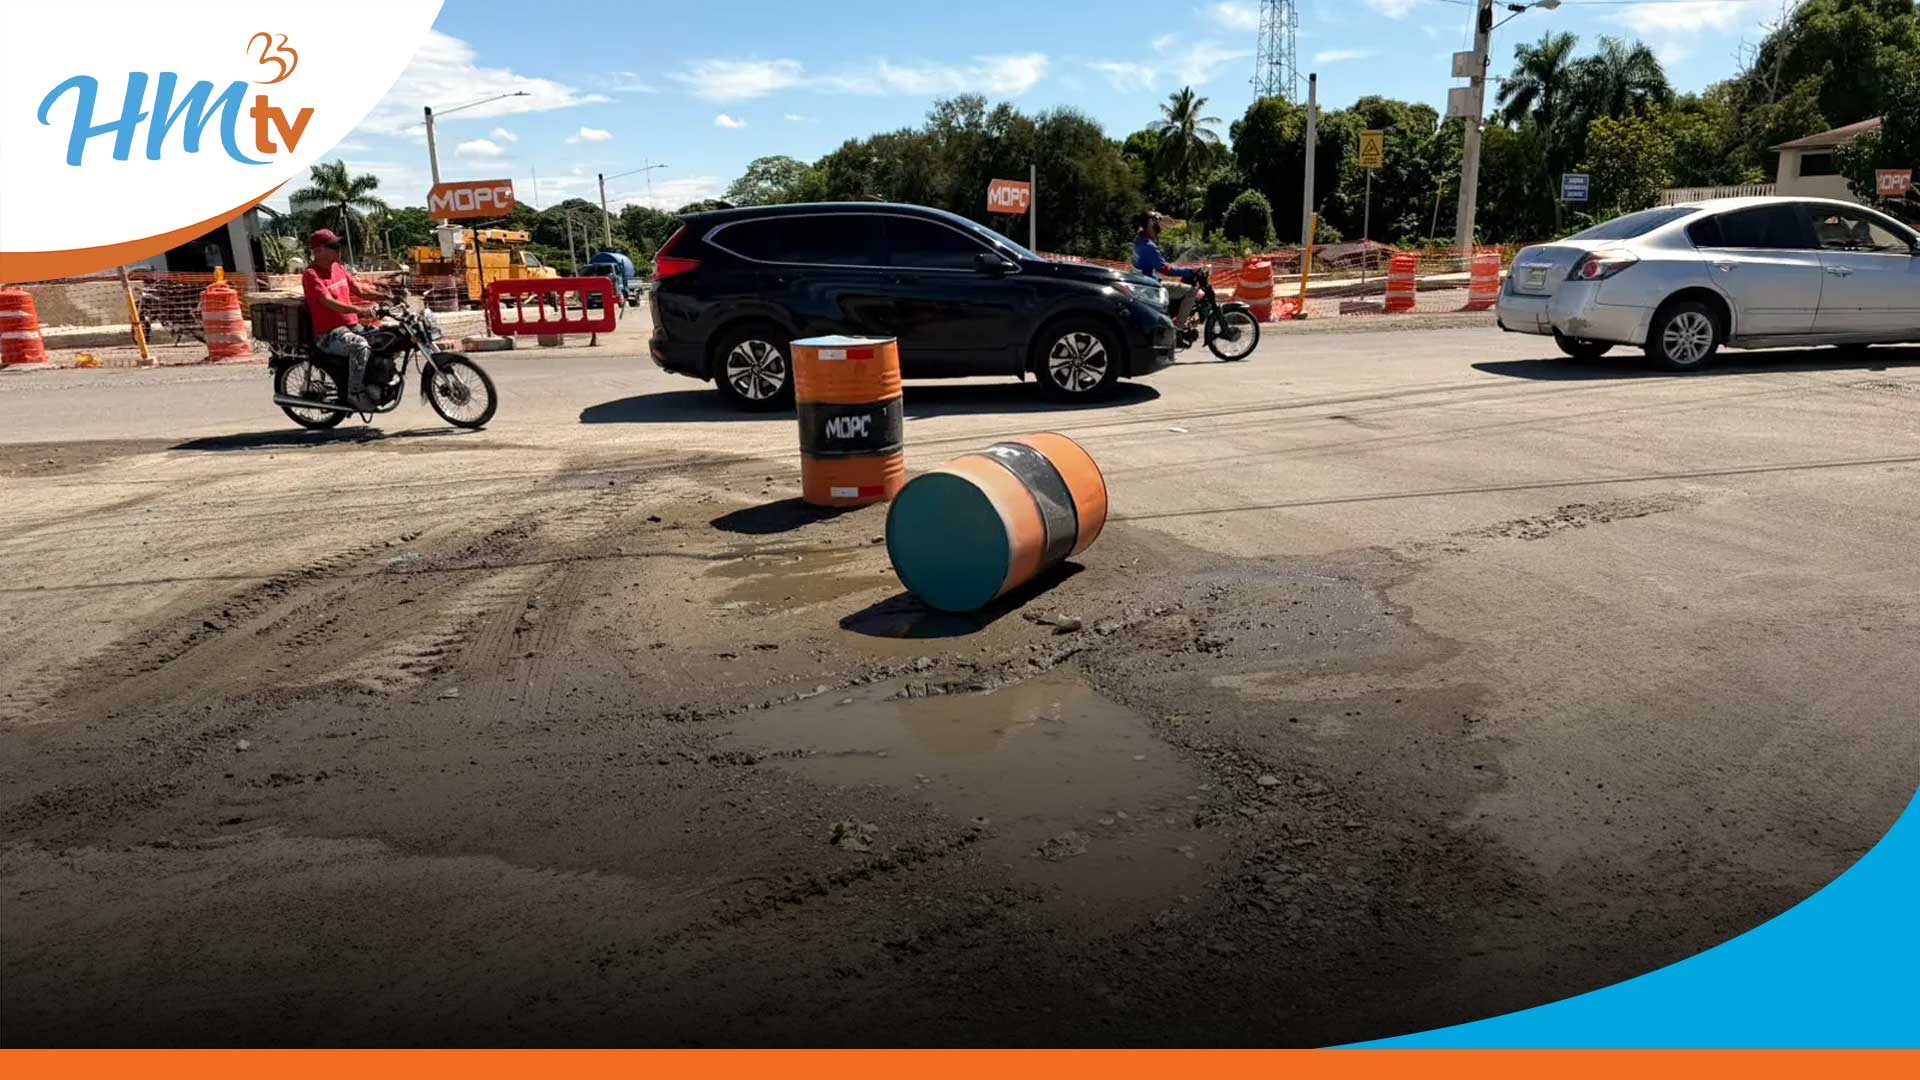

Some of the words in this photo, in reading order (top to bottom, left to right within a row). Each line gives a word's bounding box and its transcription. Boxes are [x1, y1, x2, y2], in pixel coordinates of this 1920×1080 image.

[430, 186, 512, 213] MOPC
[989, 186, 1030, 208] MOPC
[825, 414, 872, 440] MOPC
